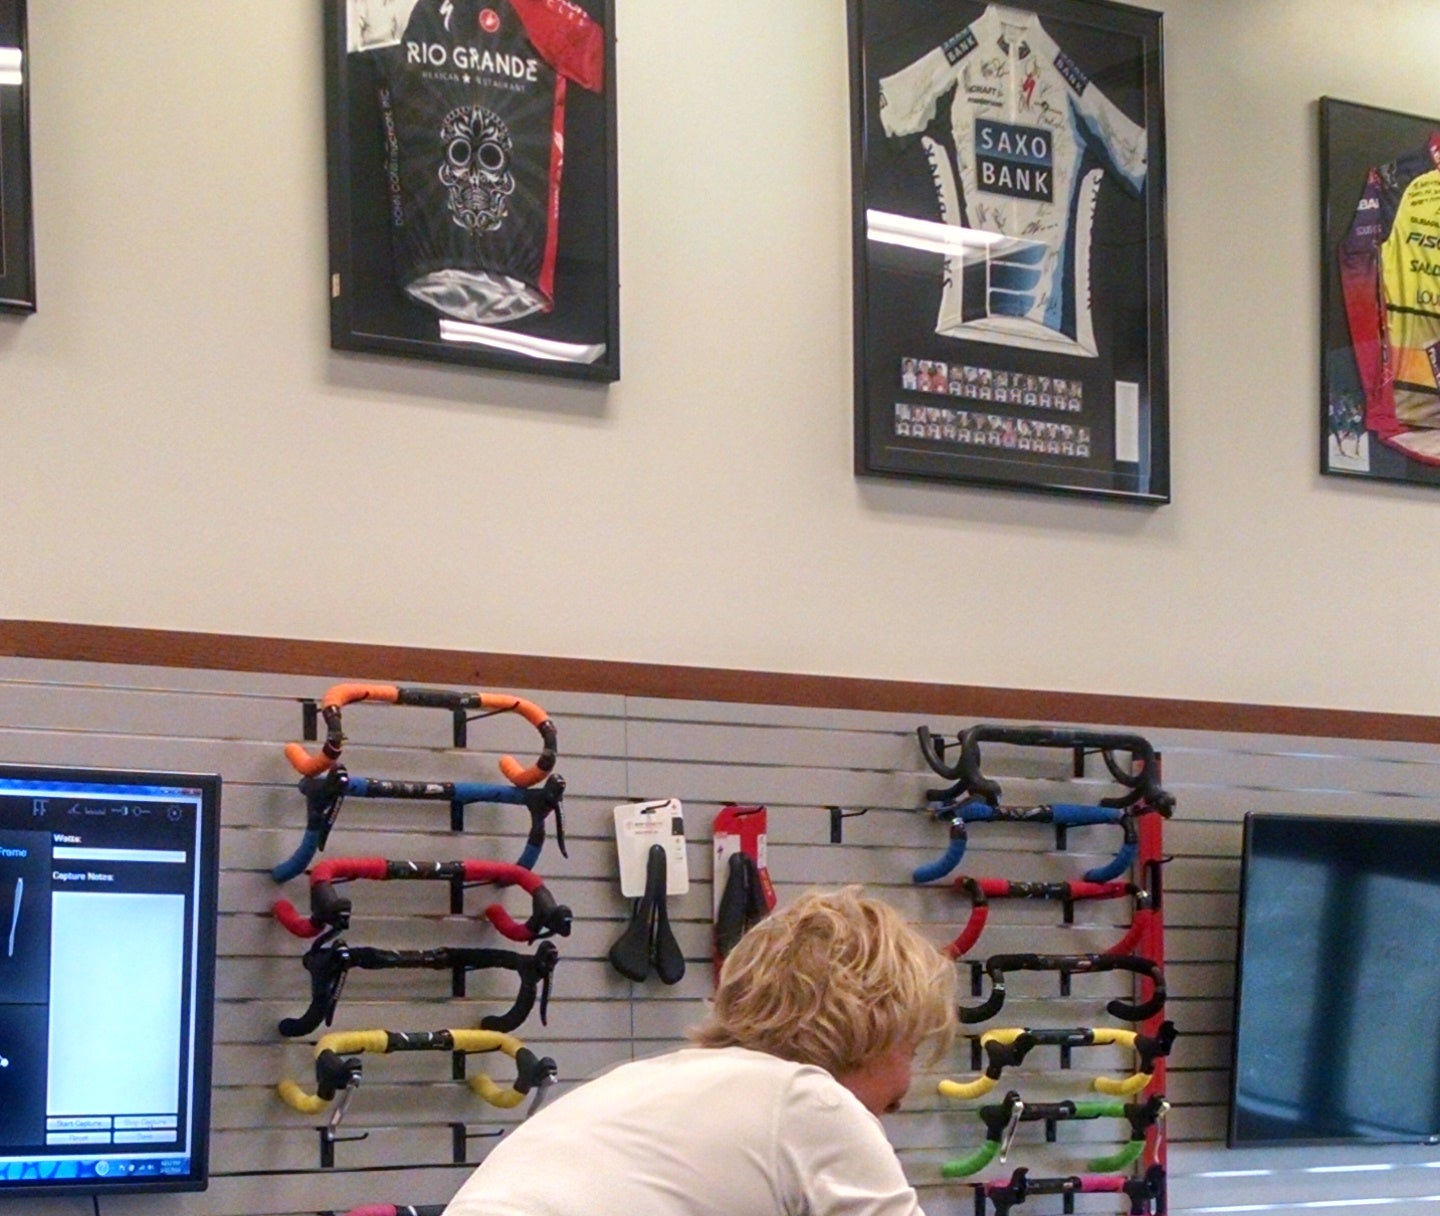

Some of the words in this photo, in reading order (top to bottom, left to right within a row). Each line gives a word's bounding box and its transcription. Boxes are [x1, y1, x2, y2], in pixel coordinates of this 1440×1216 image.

[406, 40, 447, 66] RIO
[452, 45, 539, 82] GRANDE
[981, 127, 1047, 159] SAXO
[982, 161, 1049, 195] BANK
[52, 871, 85, 881] Capture
